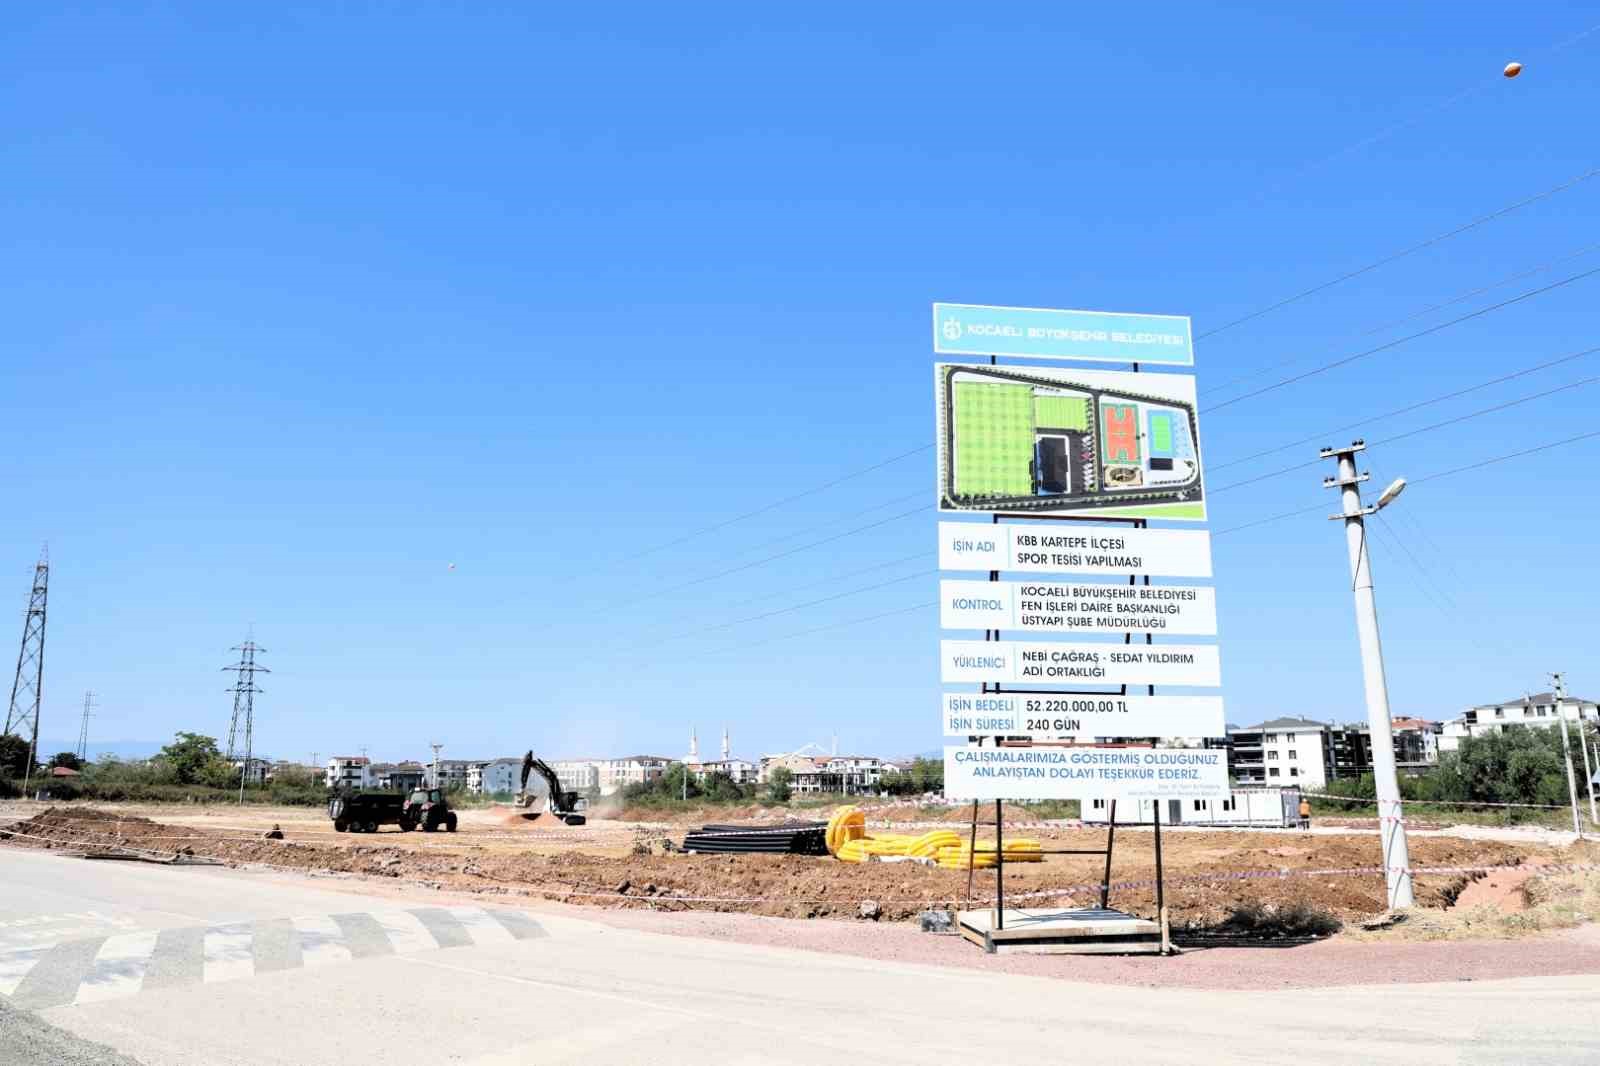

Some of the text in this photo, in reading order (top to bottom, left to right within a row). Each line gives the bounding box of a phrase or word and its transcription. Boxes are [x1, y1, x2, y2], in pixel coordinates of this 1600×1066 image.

[953, 538, 996, 553] İŞİN ADI
[1017, 535, 1125, 550] KBB KARTEPE İLÇESİ
[1017, 552, 1142, 568] SPOR TESİSİ YAPILMASI
[1021, 586, 1196, 601] KOCAELİ BÜYÜKŞEHİR BELEDİYESİ
[952, 598, 1004, 611] KONTROL
[1021, 600, 1180, 616] FEN İŞLERİ DAİRE BAŞKANLIĞI
[1022, 614, 1166, 629] ÜSTYAPI ŞUBE MÜDÜRLÜĞÜ
[1022, 649, 1048, 662] NEBİ
[1051, 649, 1099, 664] ÇAĞRAŞ
[1110, 652, 1143, 663] SEDAT
[1146, 653, 1194, 664] YILDIRIM
[1022, 664, 1105, 678] ADİ ORTAKLIĞI
[949, 696, 972, 712] İŞİN
[1026, 700, 1129, 714] 52.220.000,00 TL
[949, 714, 972, 731] İŞİN
[1026, 716, 1081, 731] 240 GÜN
[954, 751, 1067, 765] ÇALIŞMALARIMIZA
[972, 766, 1045, 780] ANLAYIŞTAN
[1049, 767, 1094, 779] DOLAYI
[1097, 767, 1154, 782] TEŞEKKÜR
